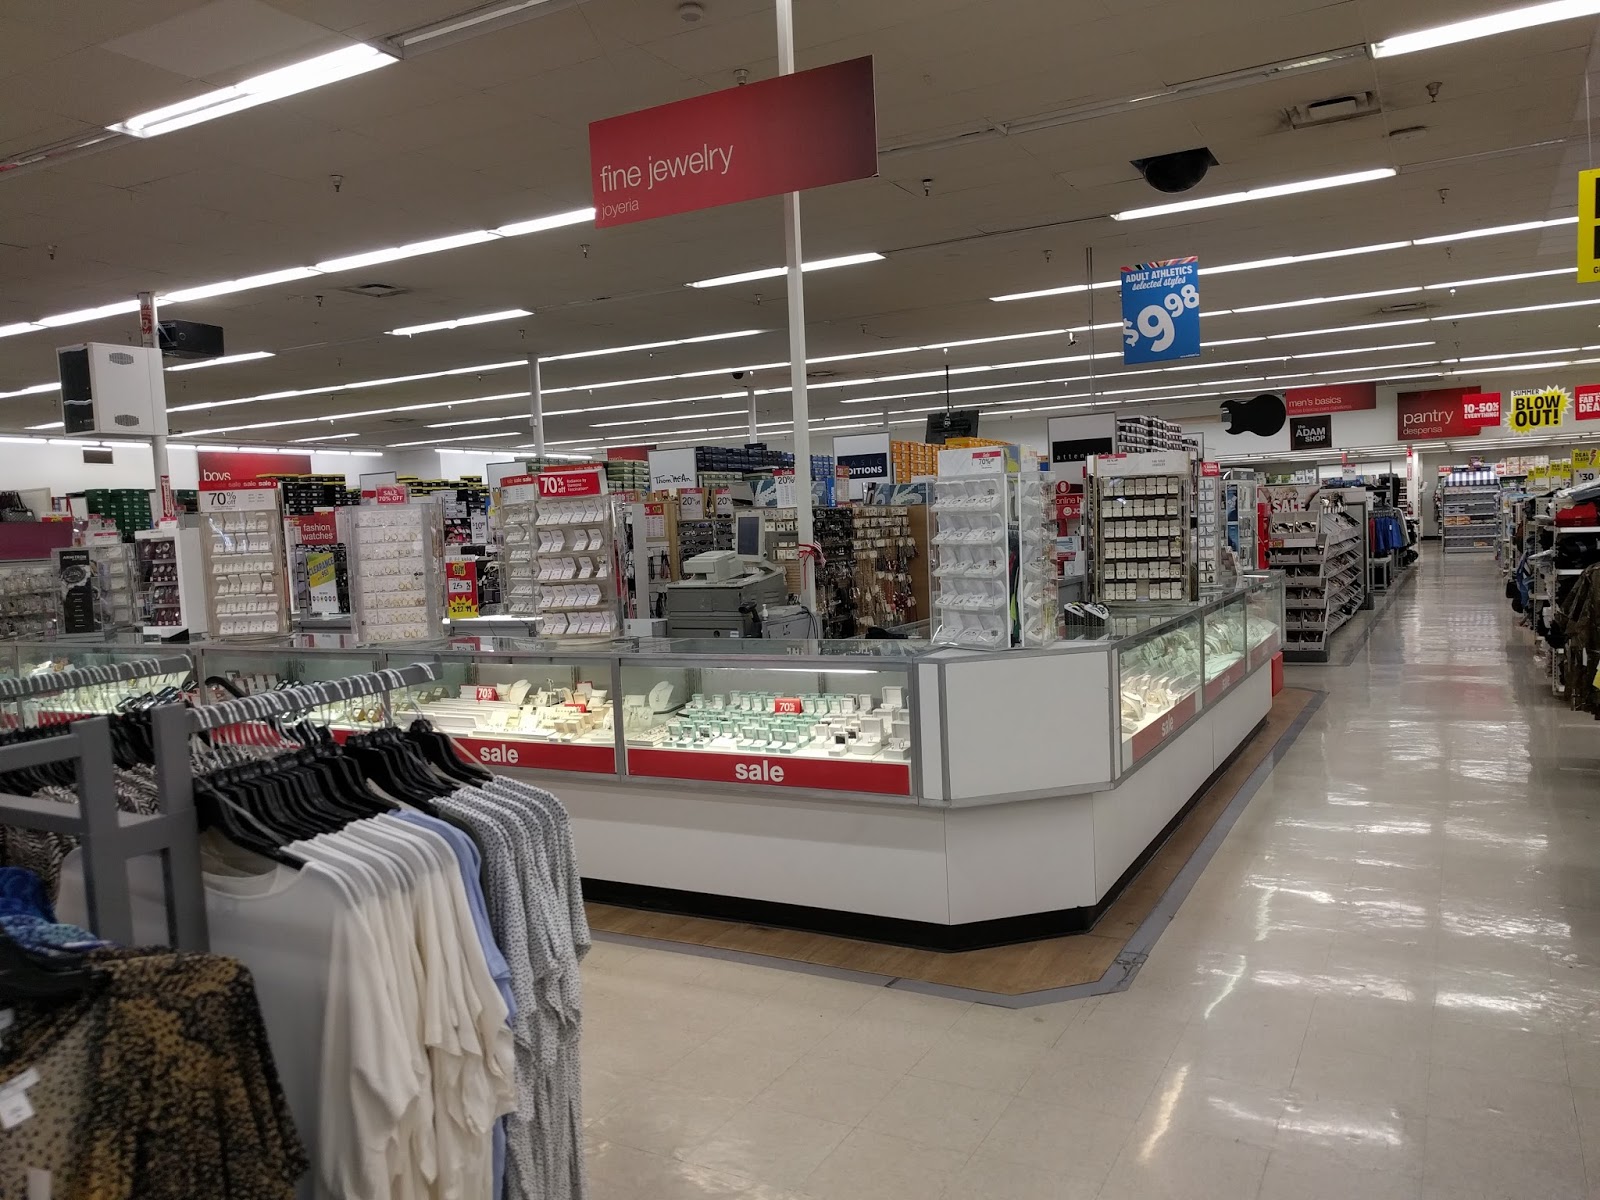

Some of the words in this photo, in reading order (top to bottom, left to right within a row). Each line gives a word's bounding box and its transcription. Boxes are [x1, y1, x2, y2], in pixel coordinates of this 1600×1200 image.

[600, 164, 641, 192] fine
[648, 143, 733, 190] jewelry
[1125, 272, 1149, 283] ADULT
[1151, 265, 1193, 280] ATHLETICS
[1131, 279, 1162, 291] selected
[1163, 276, 1186, 288] styles
[1289, 398, 1313, 407] men's
[1315, 396, 1342, 406] basics
[1464, 402, 1499, 413] 10-50%
[1515, 395, 1561, 411] BLOW
[1579, 396, 1594, 404] FAB
[1403, 409, 1454, 427] pantry
[1515, 409, 1559, 427] OUT!
[1296, 427, 1326, 437] ADAM
[1403, 426, 1443, 435] despensa
[540, 477, 564, 493] 70%
[208, 491, 237, 506] 70%
[1272, 499, 1306, 512] SALE
[303, 523, 331, 532] fashion
[302, 532, 334, 540] watches
[478, 687, 493, 698] 70%
[779, 702, 795, 711] 70%
[1161, 713, 1173, 737] sale
[480, 743, 519, 764] sale
[735, 760, 784, 782] sale
